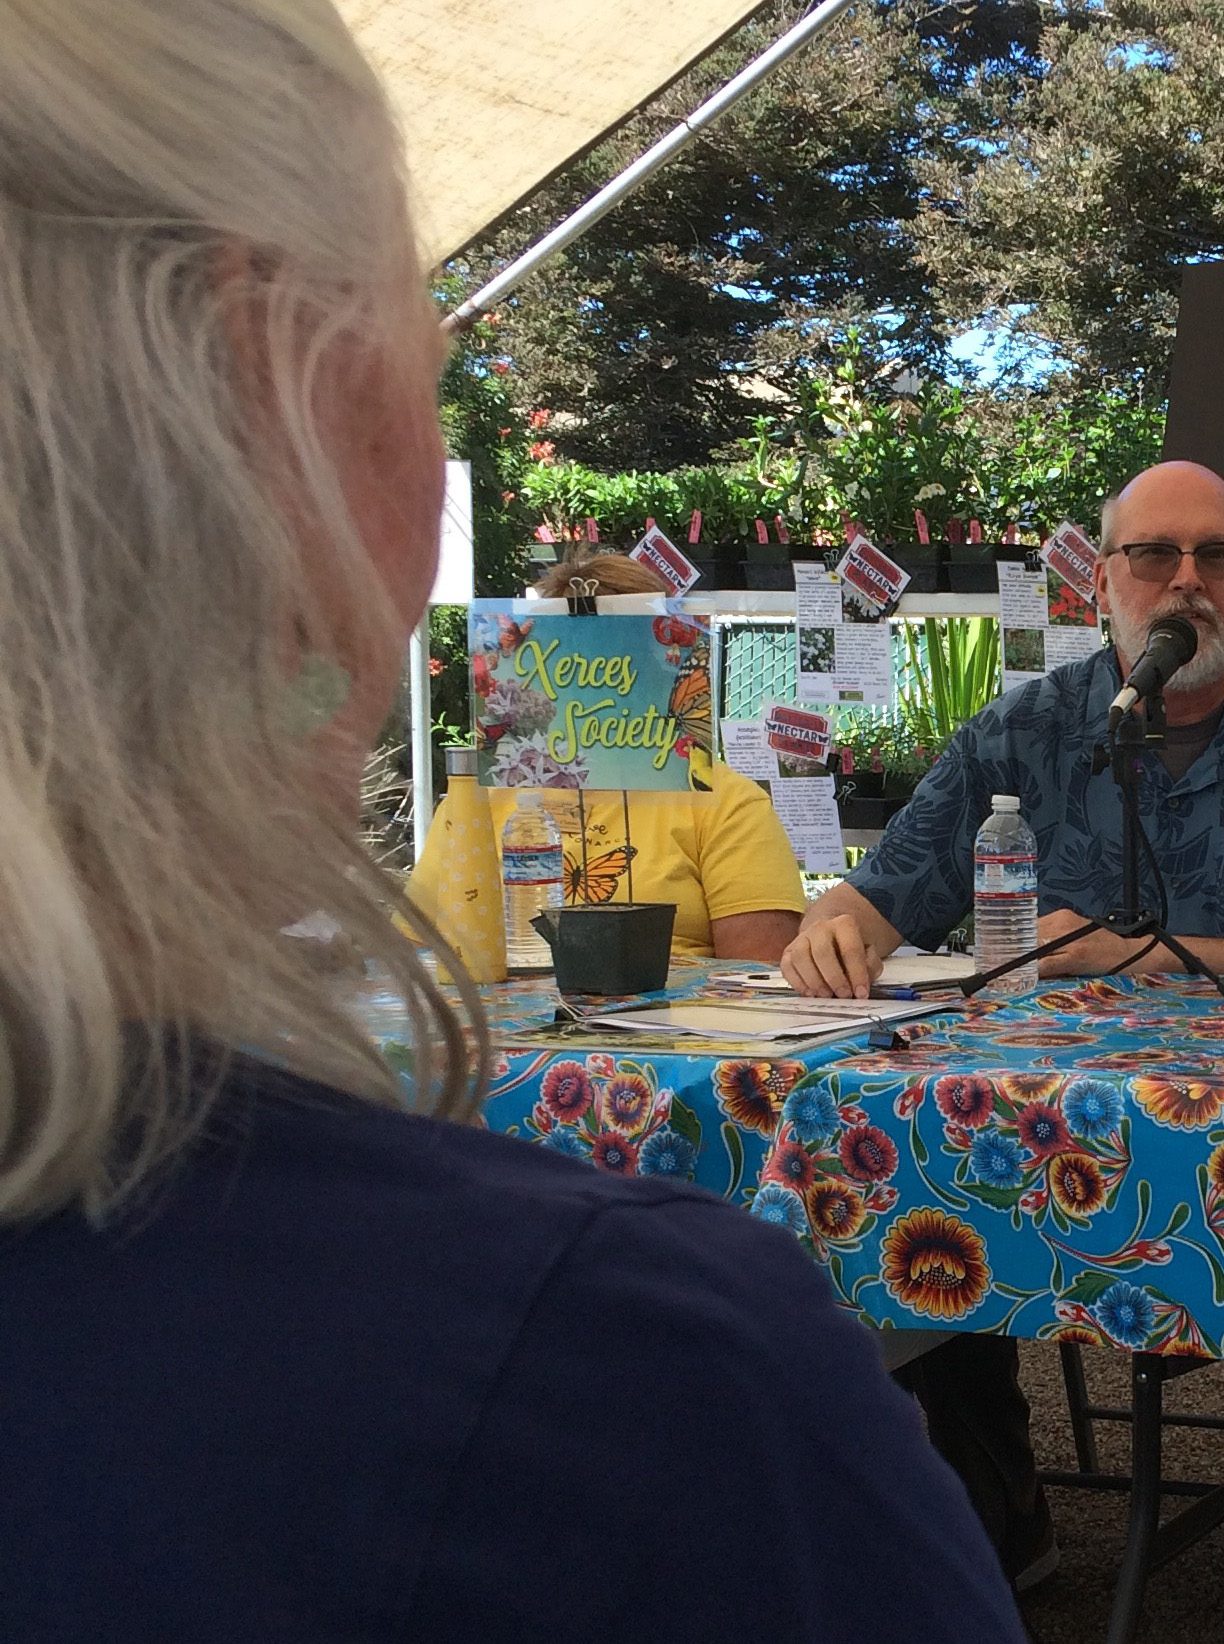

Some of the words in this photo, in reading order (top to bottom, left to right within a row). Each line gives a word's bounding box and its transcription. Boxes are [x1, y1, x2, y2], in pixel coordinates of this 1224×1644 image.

[650, 548, 679, 582] NECTAR
[857, 560, 889, 591] NECTAR
[1060, 545, 1094, 579] NECTAR
[514, 638, 637, 700] Xerces
[548, 699, 680, 769] Society
[777, 724, 818, 743] NECTAR
